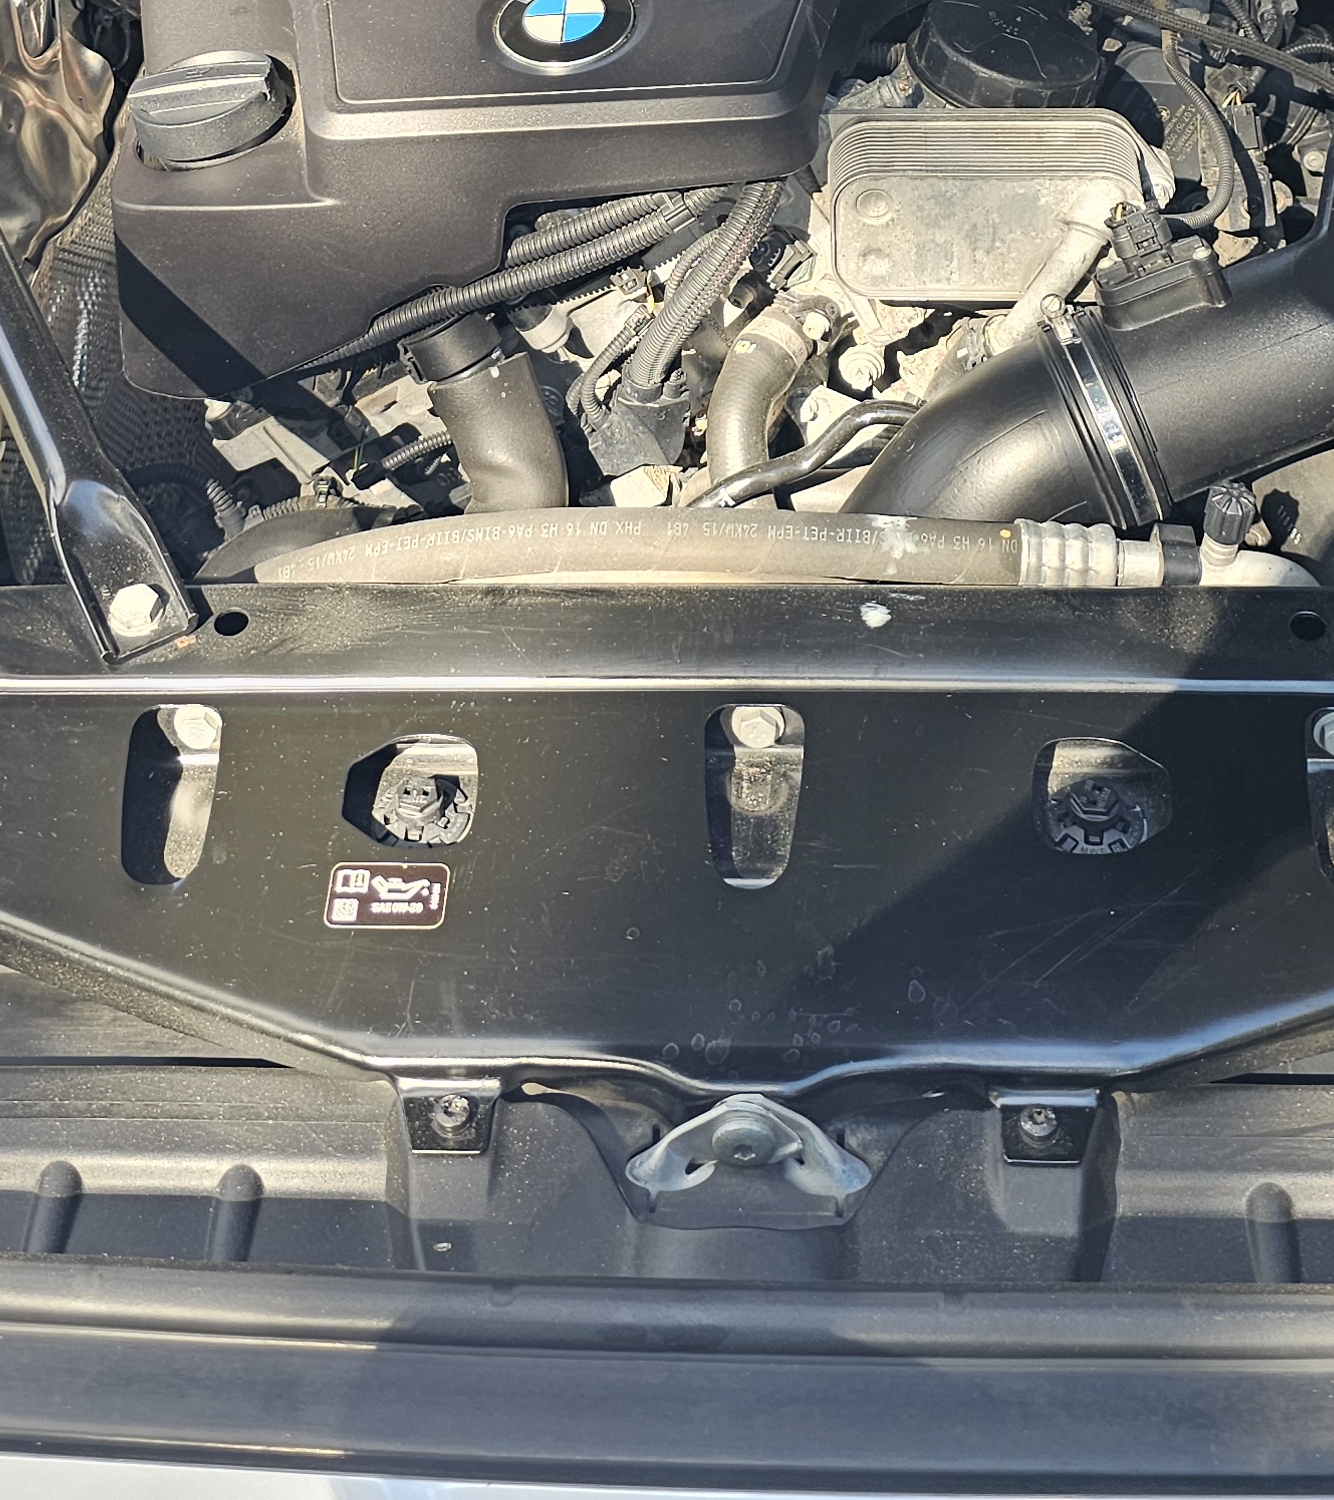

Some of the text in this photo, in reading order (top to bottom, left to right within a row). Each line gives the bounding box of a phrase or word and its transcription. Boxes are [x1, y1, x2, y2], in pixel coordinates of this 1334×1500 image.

[540, 523, 559, 538] H3
[566, 522, 582, 536] 16
[589, 521, 608, 537] DN
[702, 521, 758, 537] 24KW/15
[952, 535, 970, 550] H3
[978, 537, 993, 550] 16
[1001, 539, 1018, 553] DN
